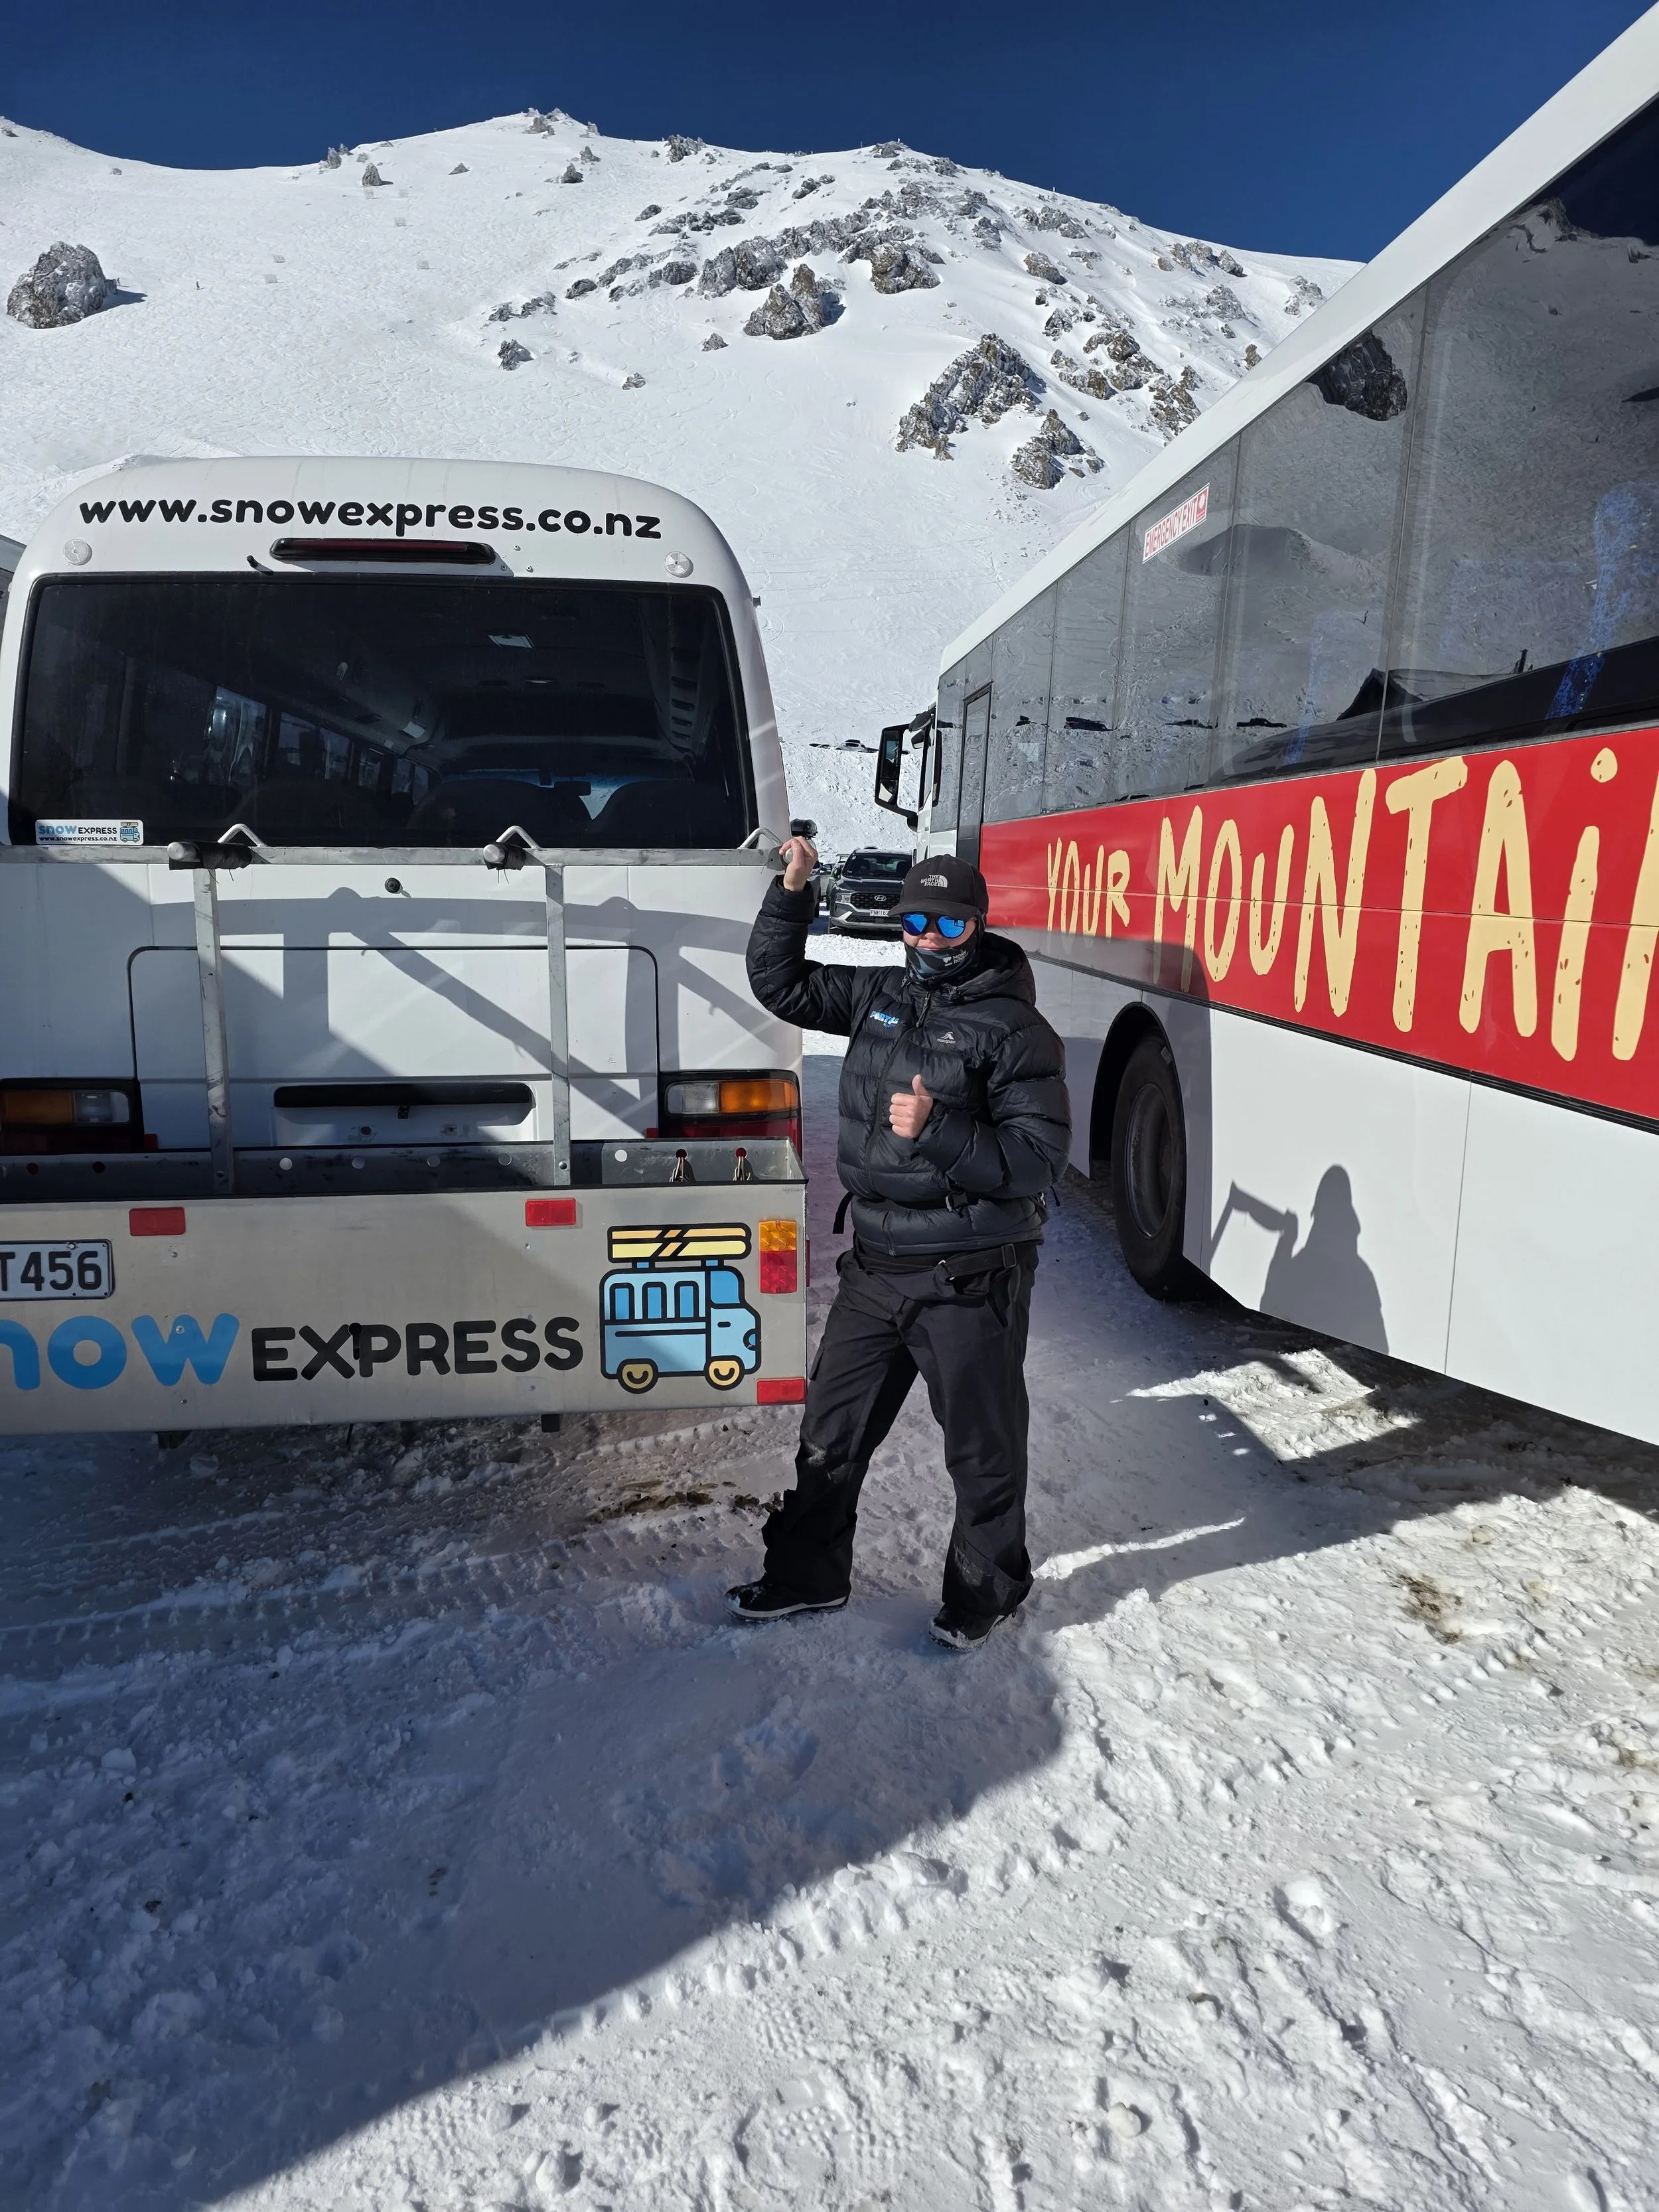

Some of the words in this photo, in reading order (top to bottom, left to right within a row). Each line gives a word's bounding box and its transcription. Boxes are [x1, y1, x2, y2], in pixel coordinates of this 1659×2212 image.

[79, 498, 662, 539] www.snowexpress.co.nz
[1145, 508, 1183, 558] EMERGENCY
[1181, 497, 1197, 532] EXIT
[38, 825, 77, 834] snow
[1047, 837, 1131, 954] YOUR
[252, 1316, 583, 1382] EXPRESS
